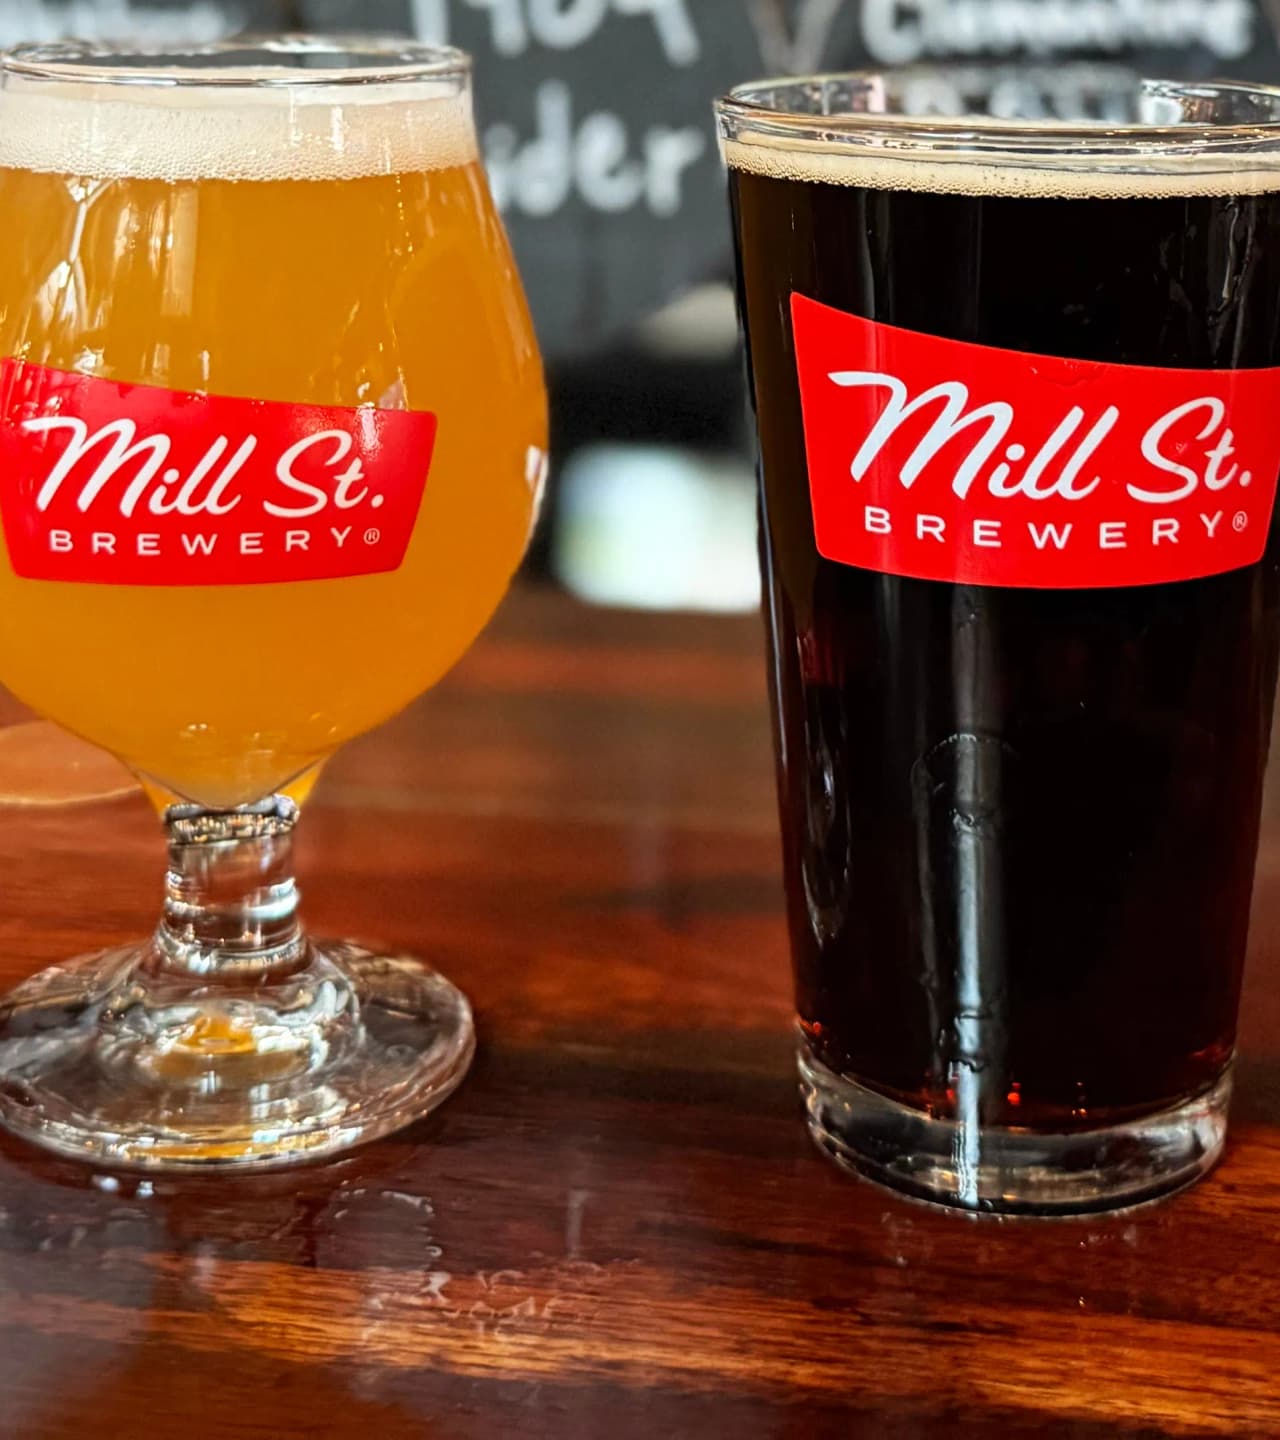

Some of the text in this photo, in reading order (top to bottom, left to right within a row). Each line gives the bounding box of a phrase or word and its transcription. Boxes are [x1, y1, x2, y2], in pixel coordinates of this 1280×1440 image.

[482, 78, 707, 218] ider
[21, 416, 385, 518] Mill St.
[827, 370, 1253, 504] Mill St.
